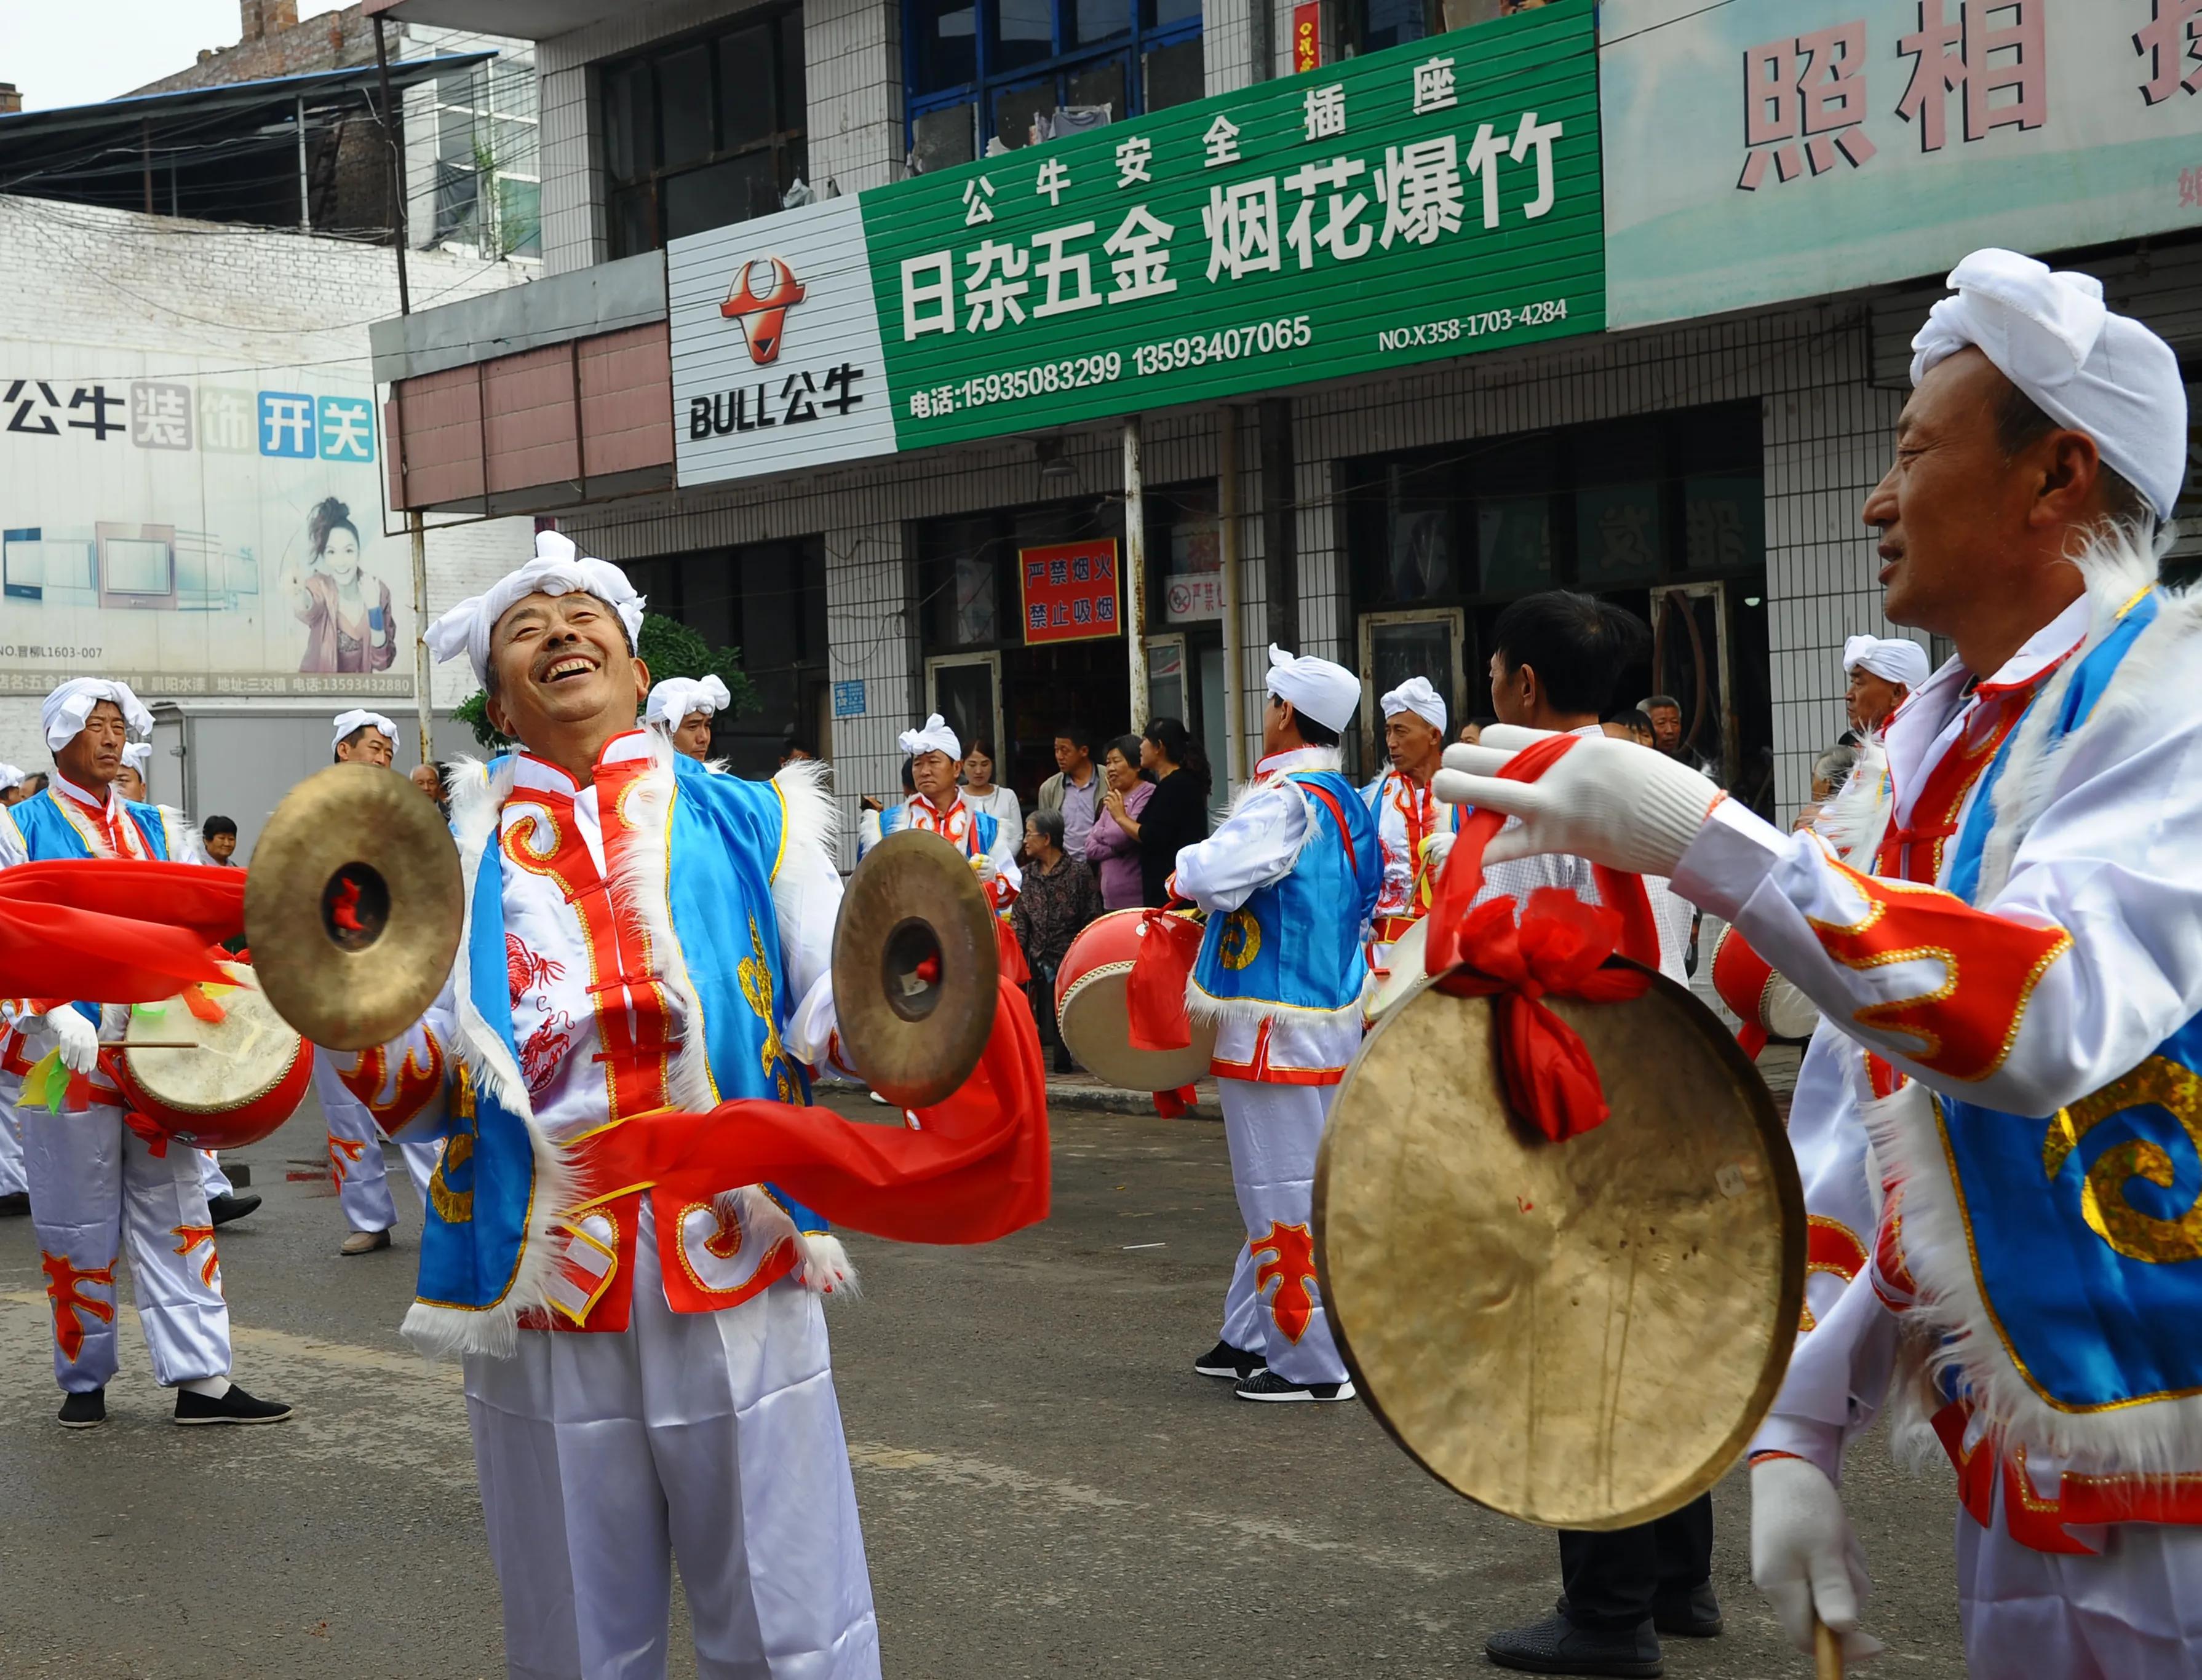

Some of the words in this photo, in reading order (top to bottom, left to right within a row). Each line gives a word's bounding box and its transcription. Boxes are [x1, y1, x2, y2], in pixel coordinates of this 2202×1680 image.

[963, 57, 1458, 226] 公牛安全插座
[900, 204, 1177, 342] 日杂五金
[1202, 113, 1563, 283] 烟花爆竹
[1380, 298, 1568, 352] NO.X358-1703-4284
[690, 382, 775, 440] BULL
[779, 362, 864, 426] 公牛
[910, 352, 1121, 419] 电话:15935083299
[1132, 315, 1311, 376] 13593407065
[2, 379, 370, 458] 公牛装饰开关
[1027, 553, 1113, 588] 严禁烟火
[1028, 595, 1114, 630] 禁止吸烟
